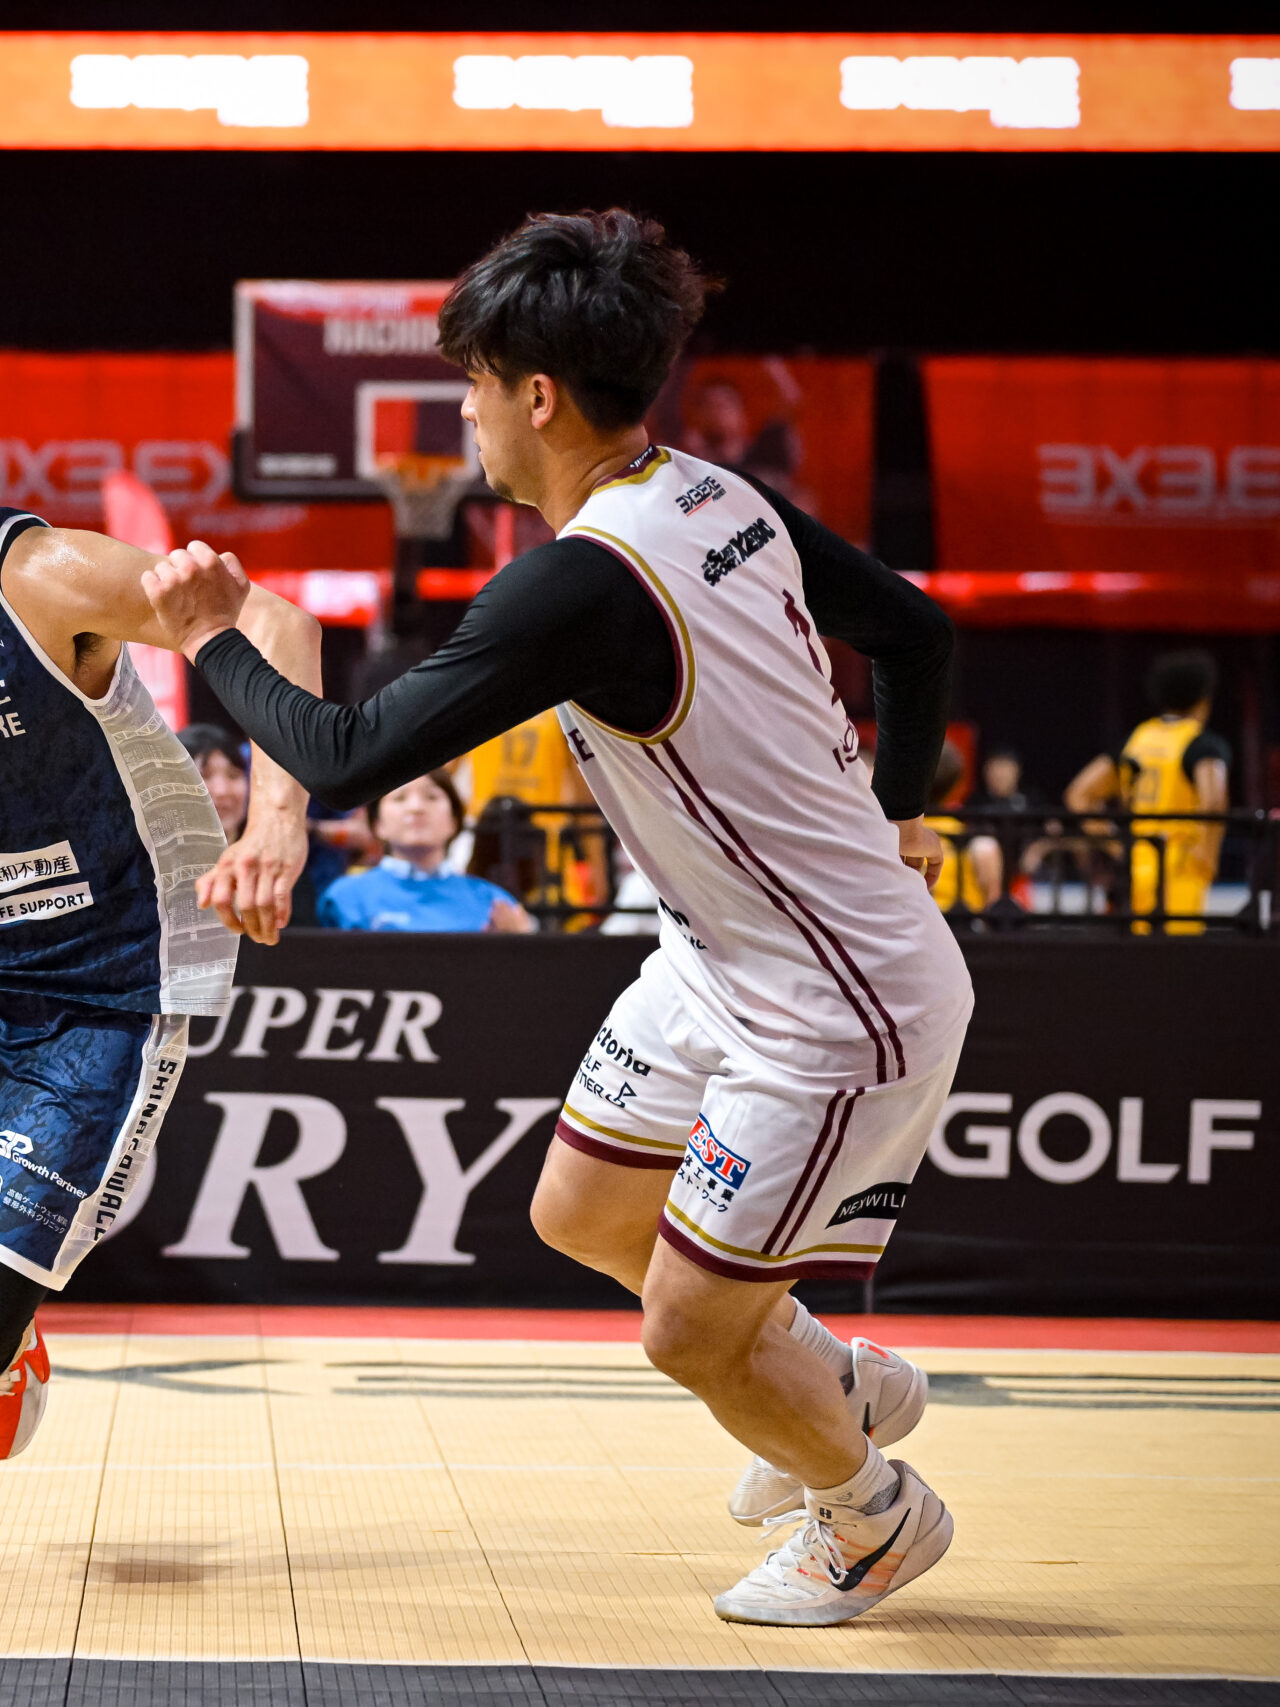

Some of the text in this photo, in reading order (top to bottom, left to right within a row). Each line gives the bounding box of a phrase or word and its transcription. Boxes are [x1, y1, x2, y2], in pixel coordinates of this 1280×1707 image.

[19, 893, 85, 915] SUPPORT
[926, 1091, 1262, 1185] GOLF
[12, 1152, 88, 1200] Growth Partner
